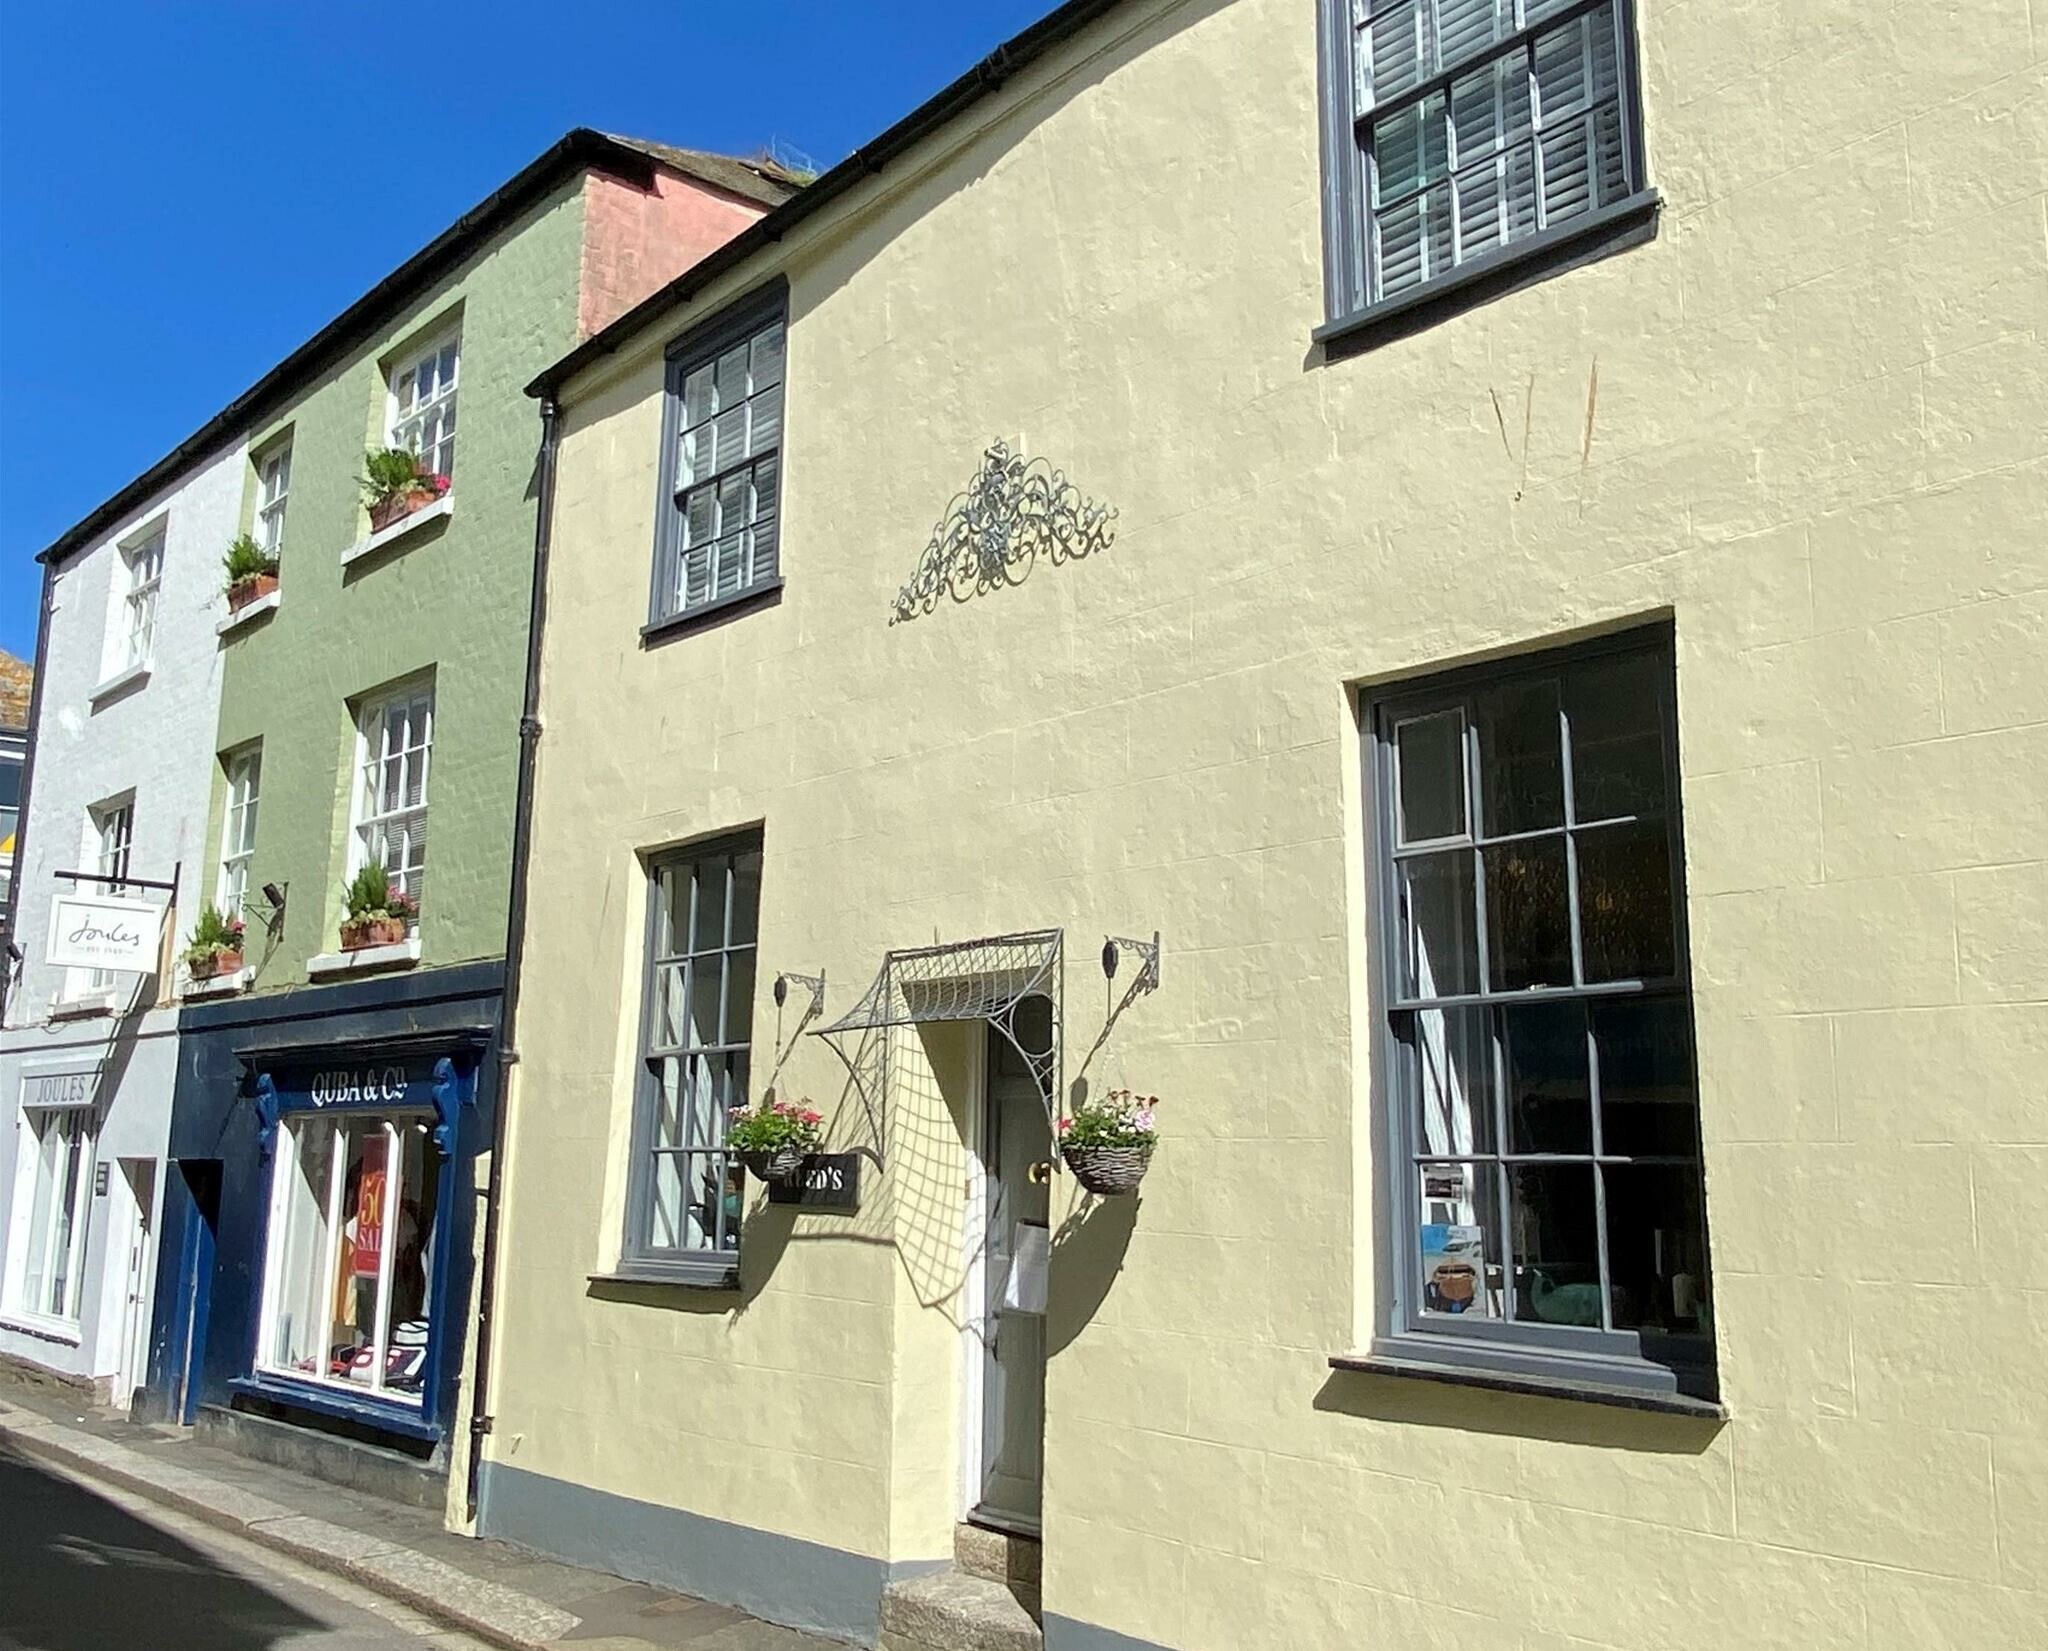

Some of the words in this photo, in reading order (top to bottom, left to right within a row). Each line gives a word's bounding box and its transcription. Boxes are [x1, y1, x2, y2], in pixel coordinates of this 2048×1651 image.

[37, 1077, 85, 1102] JOULES
[311, 1071, 361, 1107] QUBA
[363, 1068, 379, 1101] &
[359, 1227, 380, 1251] SAL
